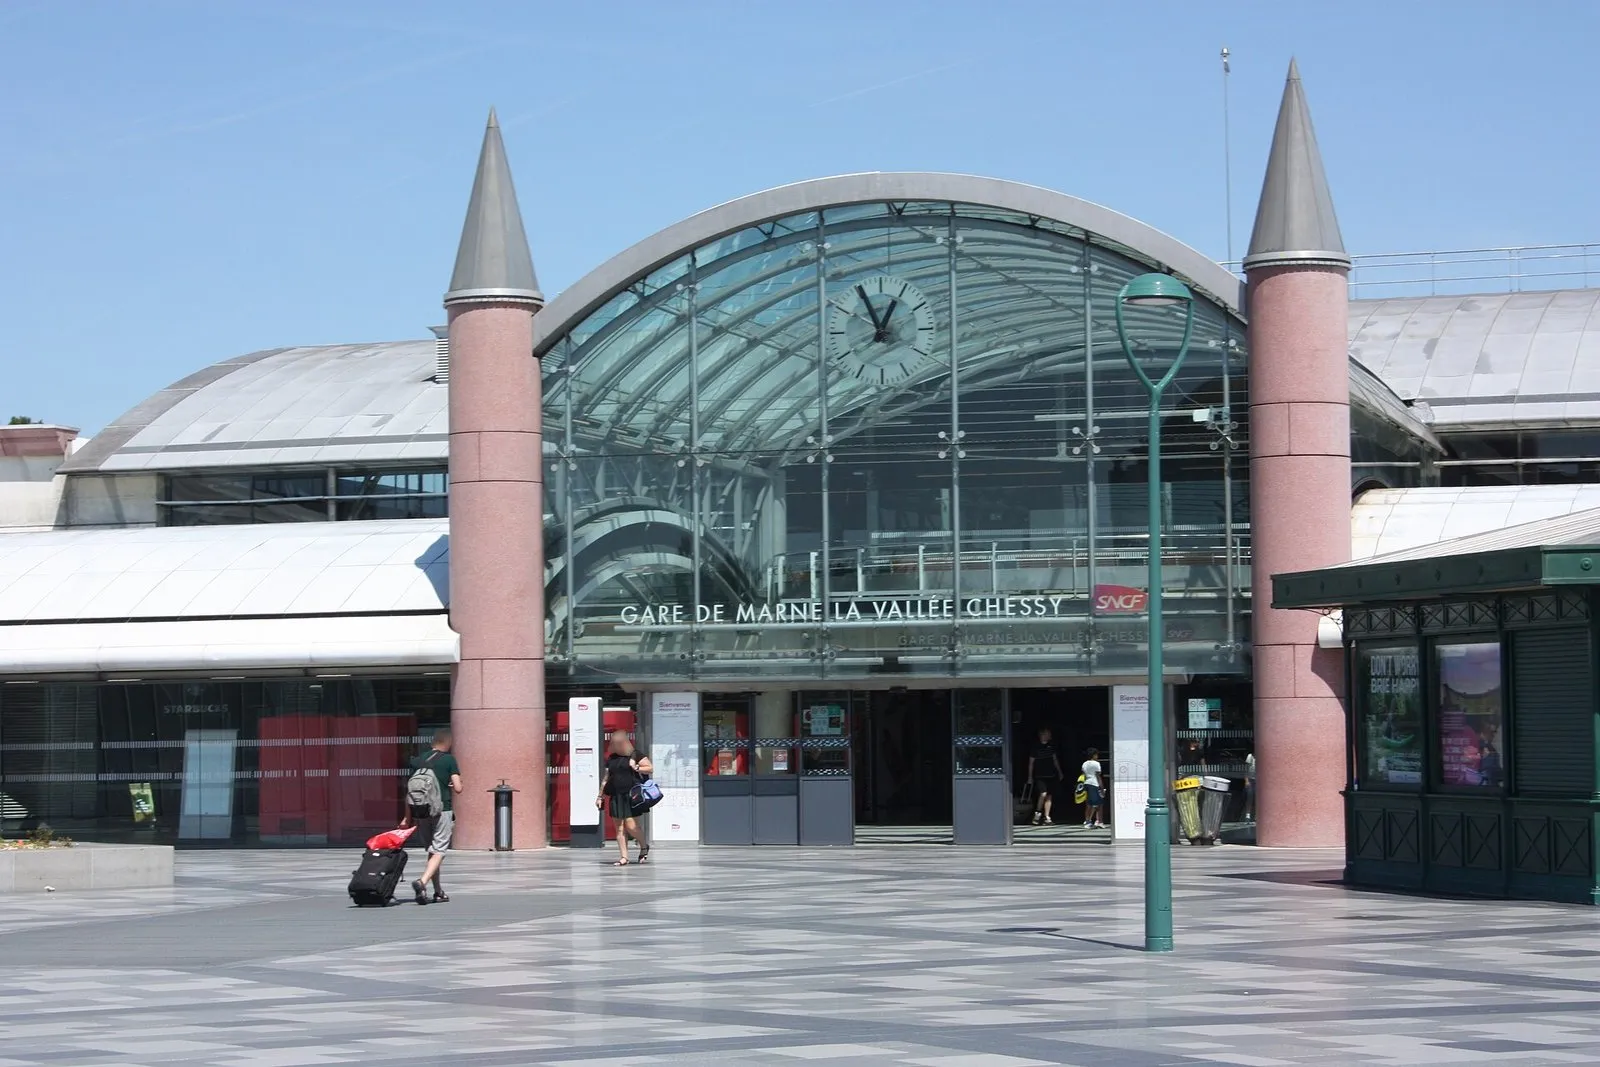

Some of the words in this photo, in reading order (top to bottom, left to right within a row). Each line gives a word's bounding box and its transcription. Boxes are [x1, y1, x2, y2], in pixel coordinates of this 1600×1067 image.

[1096, 594, 1144, 609] SNCF
[620, 605, 684, 624] GARE
[696, 604, 725, 622] DE
[736, 602, 823, 622] MARNE
[835, 602, 861, 620] LA
[873, 595, 954, 619] VALLÉE
[967, 597, 1062, 617] CHESSY
[899, 634, 936, 645] GARE
[163, 704, 229, 714] STARBUCKS
